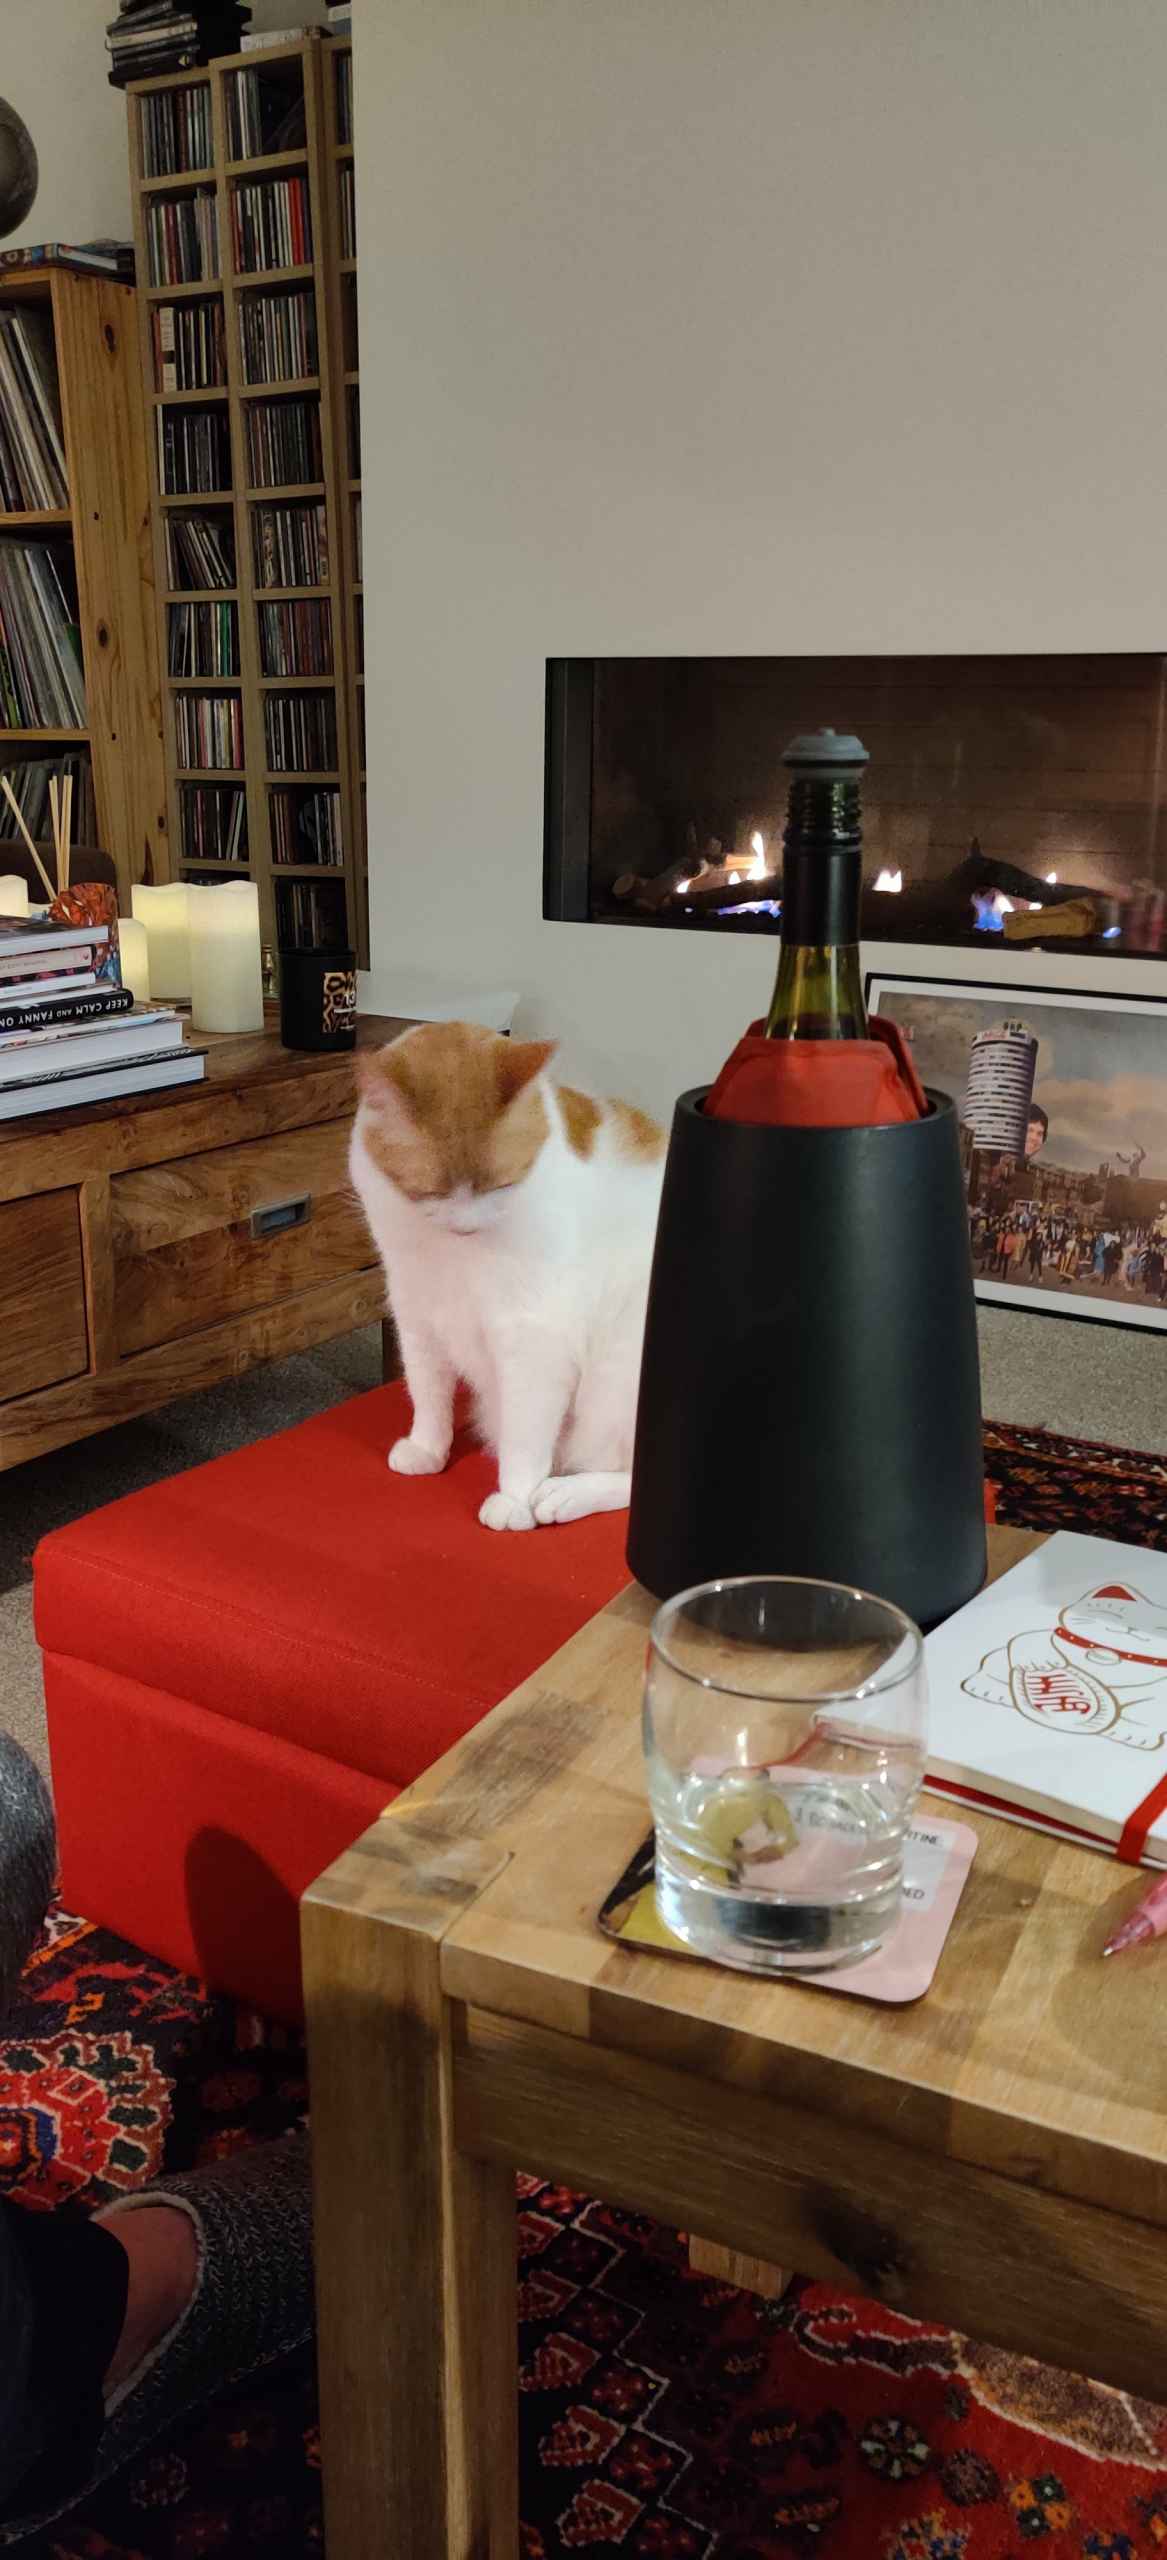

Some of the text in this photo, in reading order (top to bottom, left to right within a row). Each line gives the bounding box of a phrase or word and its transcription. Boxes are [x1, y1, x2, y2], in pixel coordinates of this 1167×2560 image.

[75, 1002, 103, 1015] CALM
[105, 998, 129, 1011] KEEP
[18, 1010, 54, 1026] FANNY
[56, 1008, 73, 1018] AND
